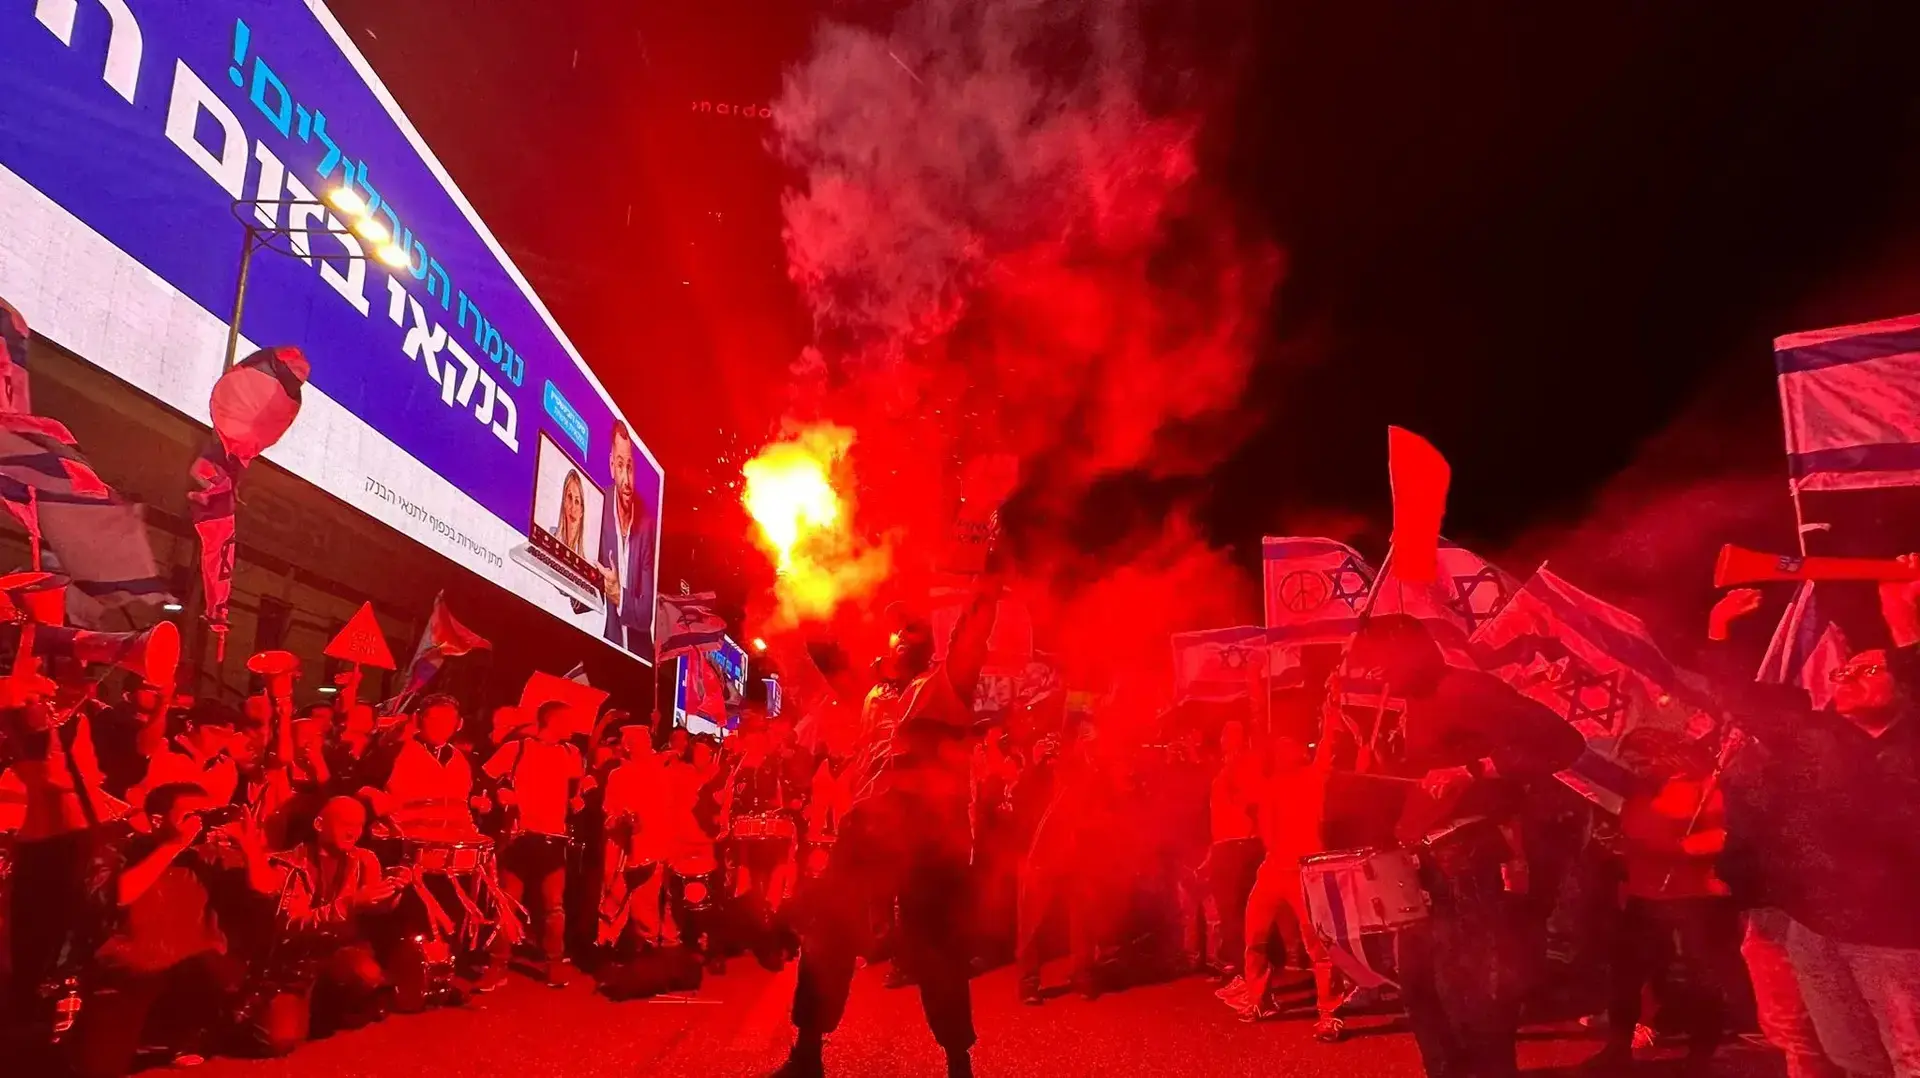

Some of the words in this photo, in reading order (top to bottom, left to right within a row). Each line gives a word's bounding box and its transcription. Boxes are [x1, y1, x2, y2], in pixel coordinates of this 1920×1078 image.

[165, 58, 370, 318] בזום
[458, 289, 525, 387] נגמרו
[387, 274, 519, 454] בנקאי
[365, 476, 396, 504] הבנק
[398, 495, 428, 523] לתנאי
[429, 516, 456, 541] בכפוף
[457, 531, 487, 560] השירות
[487, 551, 503, 568] מתן
